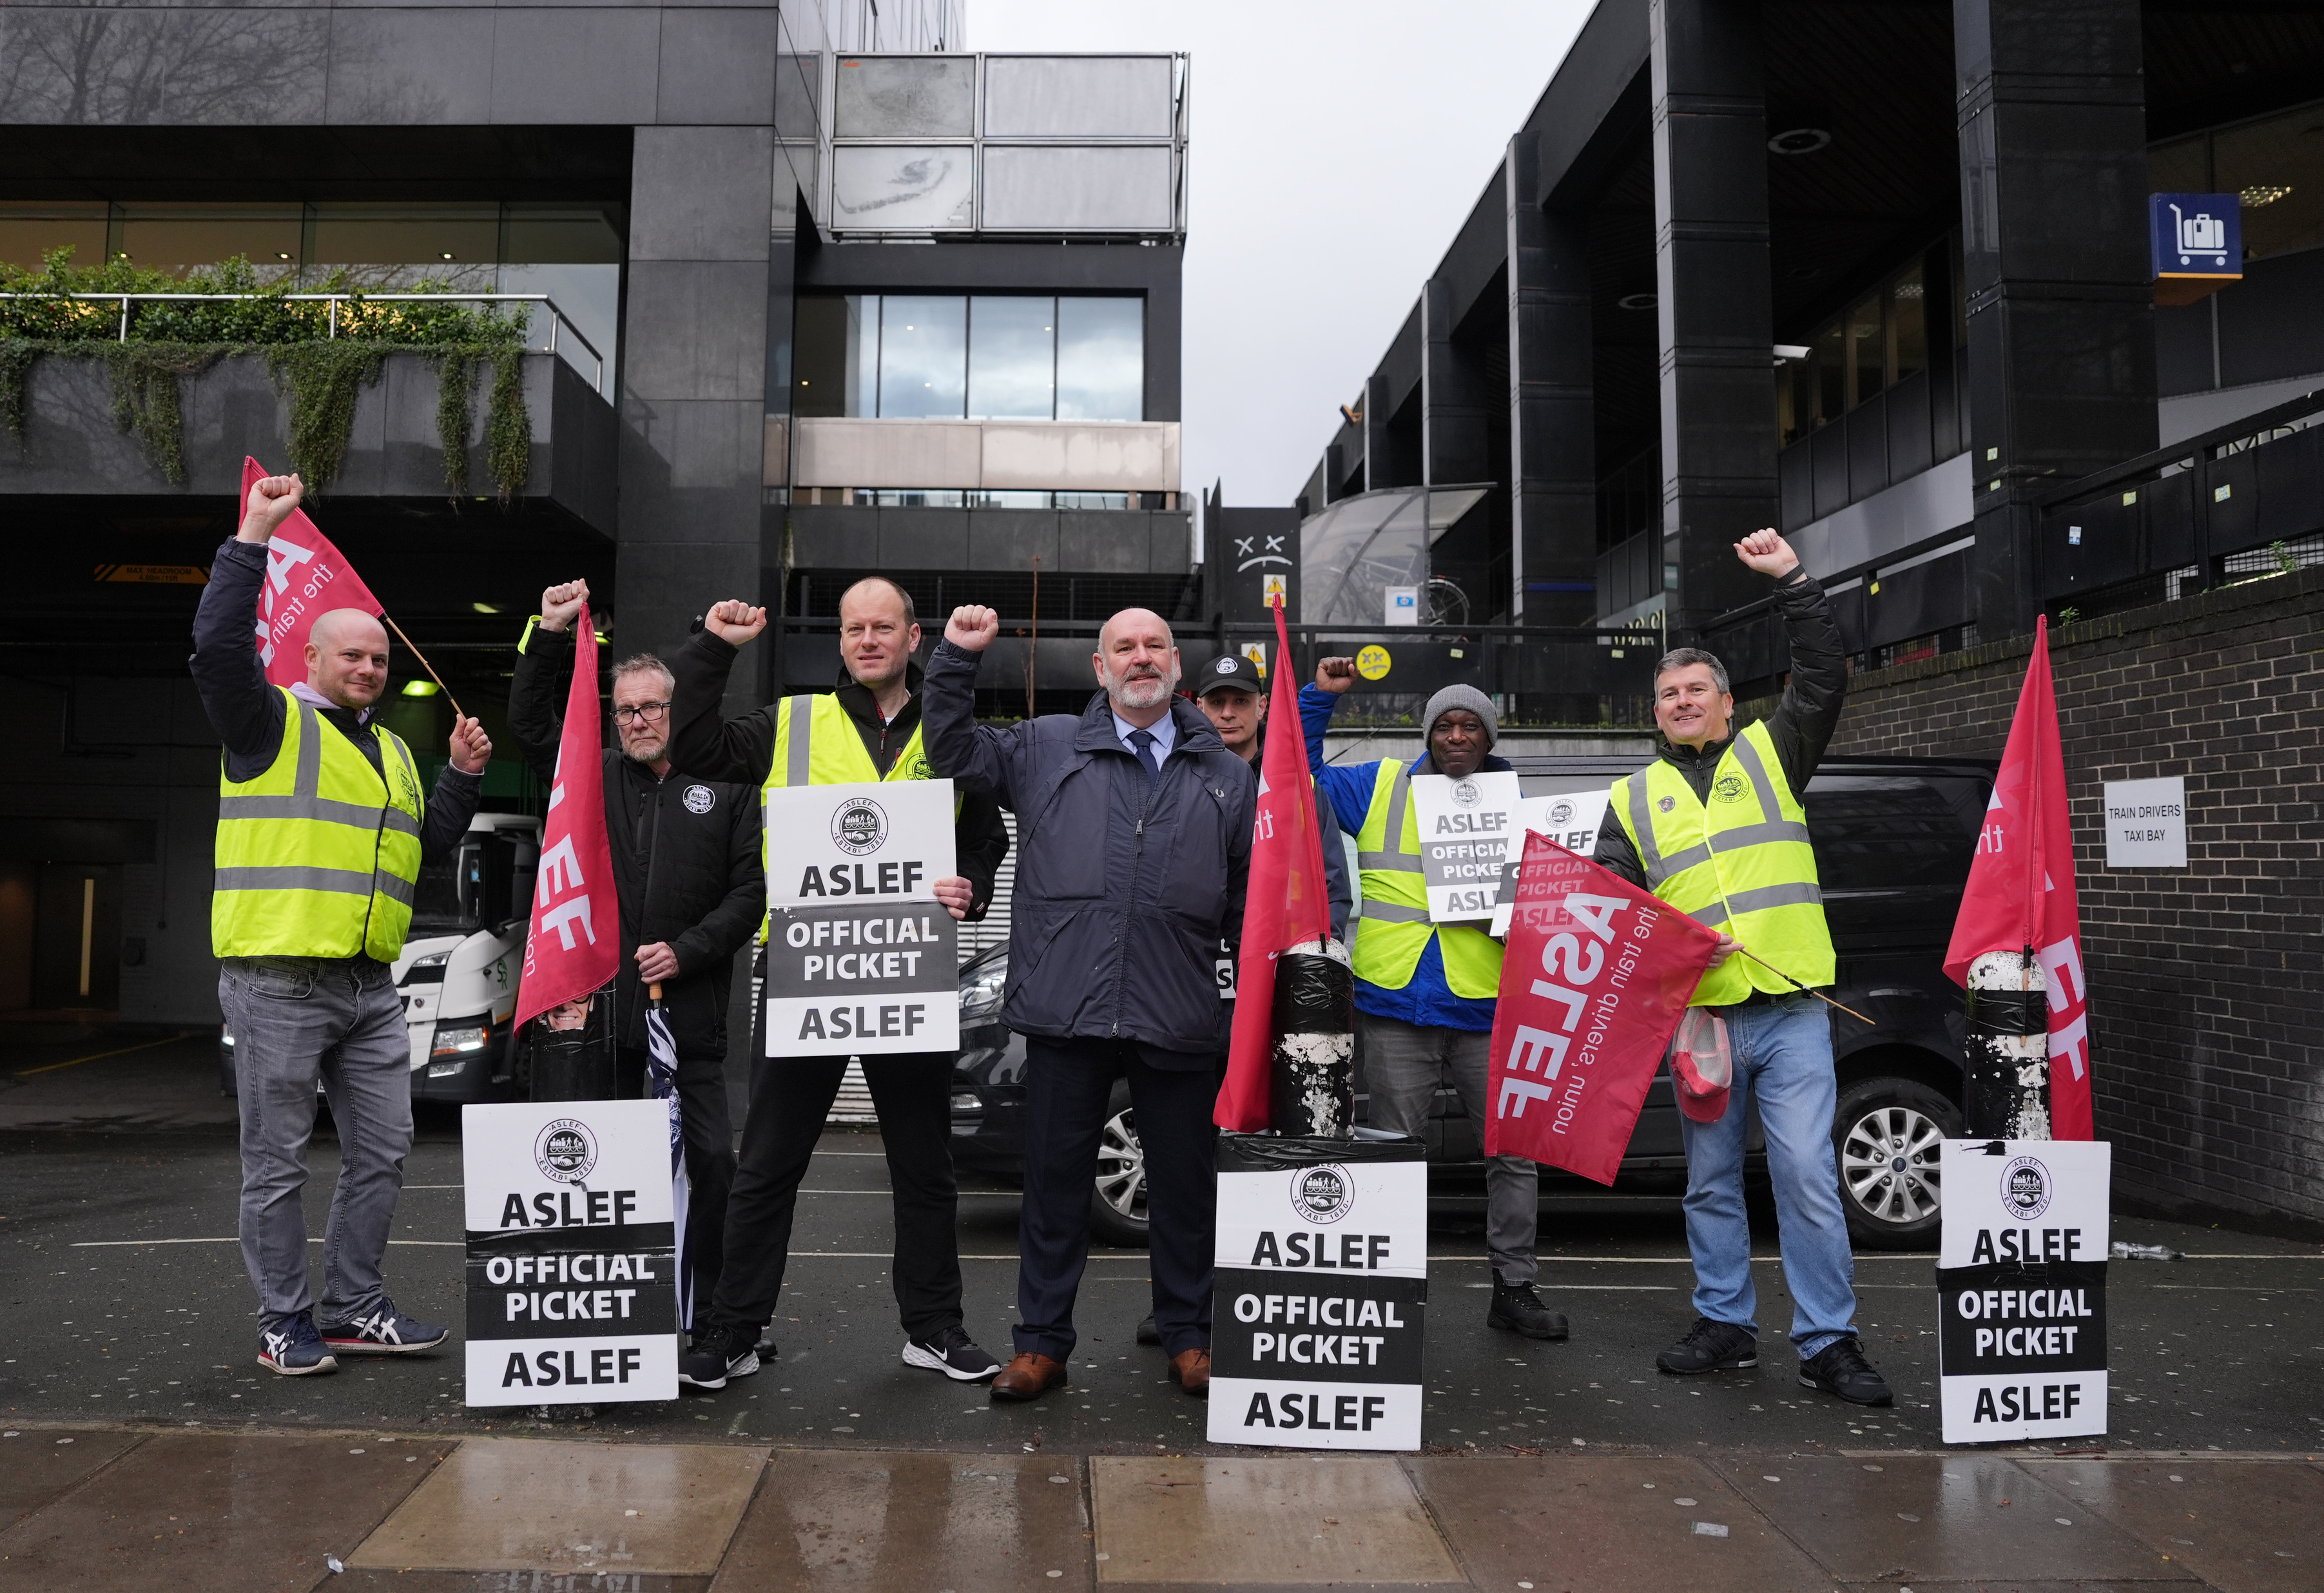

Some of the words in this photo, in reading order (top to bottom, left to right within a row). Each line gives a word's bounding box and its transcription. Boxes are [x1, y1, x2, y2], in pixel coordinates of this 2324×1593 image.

[846, 800, 873, 809] ASLEF
[2109, 807, 2136, 819] TRAIN
[2139, 804, 2181, 818] DRIVERS
[1436, 812, 1507, 835] ASLEF
[2124, 830, 2144, 842] TAXI
[2147, 829, 2165, 841] BAY
[866, 835, 884, 851] 1880
[1431, 842, 1507, 860] OFFICIA
[1525, 829, 1594, 854] ASLEF
[799, 861, 923, 898] ASLEF
[1442, 862, 1506, 879] PICKE
[1448, 890, 1499, 912] ASL
[1516, 879, 1585, 896] PICKET
[786, 916, 939, 949] OFFICIAL
[804, 951, 922, 981] PICKET
[798, 1003, 925, 1041] ASLEF
[551, 1121, 580, 1130] ASLEF
[574, 1161, 592, 1179] 1880
[2014, 1158, 2038, 1168] ASLEF
[500, 1190, 637, 1228] ASLEF
[1330, 1203, 1348, 1220] 1880
[2033, 1199, 2048, 1215] 1880
[1250, 1231, 1391, 1270] ASLEF
[1971, 1228, 2081, 1263] ASLEF
[486, 1253, 655, 1285] OFFICIAL
[506, 1289, 637, 1322] PICKET
[1234, 1293, 1404, 1328] OFFICIAL
[1958, 1289, 2092, 1320] OFFICIAL
[1252, 1331, 1385, 1366] PICKET
[1975, 1326, 2078, 1357] PICKET
[501, 1348, 641, 1387] ASLEF
[1243, 1391, 1386, 1432] ASLEF
[1973, 1384, 2081, 1424] ASLEF
